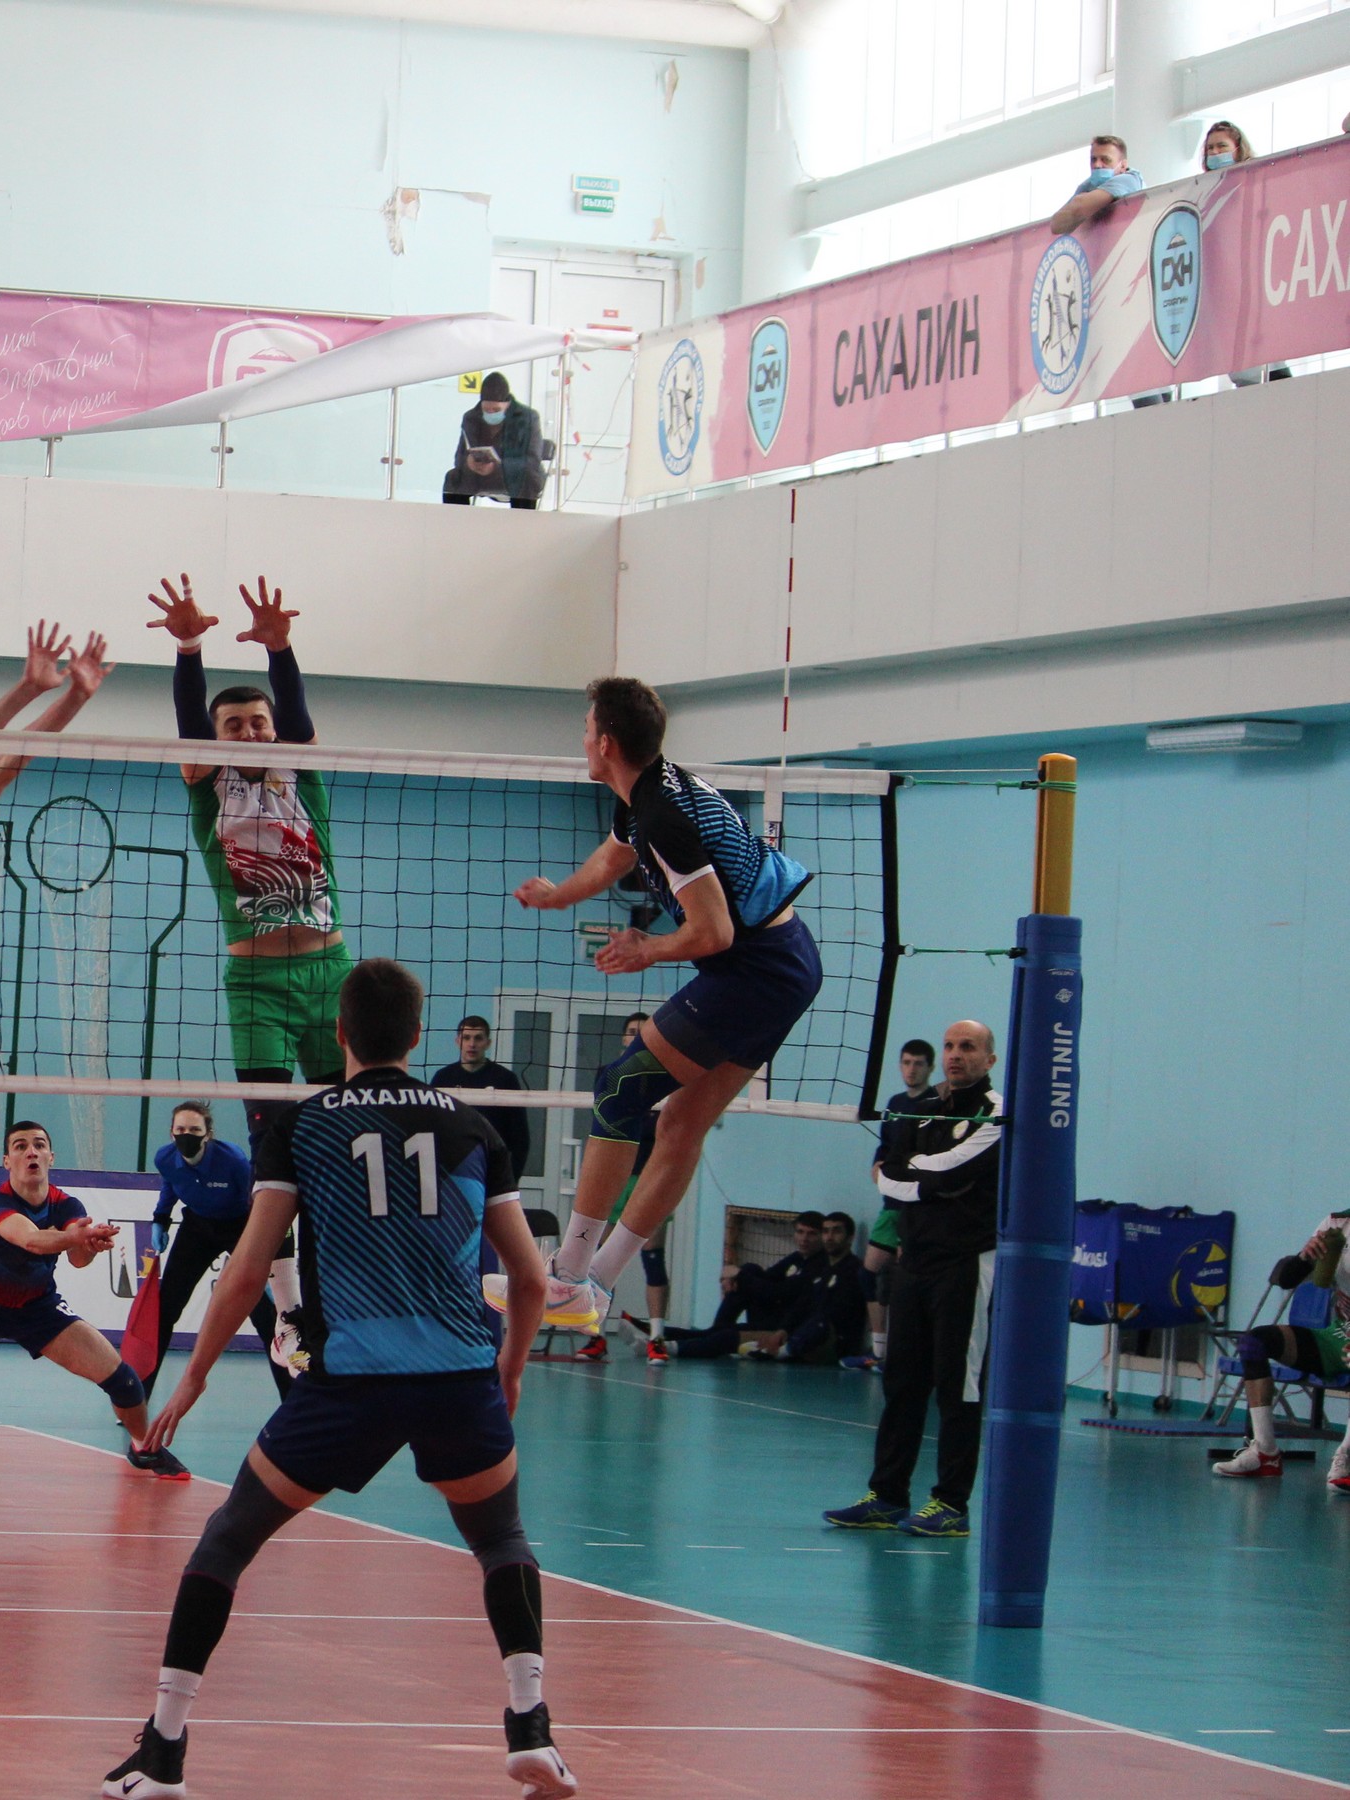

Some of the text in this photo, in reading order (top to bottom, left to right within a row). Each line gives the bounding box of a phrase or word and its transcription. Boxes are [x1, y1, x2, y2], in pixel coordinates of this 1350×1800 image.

[583, 197, 614, 210] ВЫХОД
[1264, 199, 1350, 306] САХ
[833, 295, 980, 408] САХАЛИН
[322, 1088, 456, 1112] САХАЛИН
[1049, 1022, 1074, 1128] JINLING
[351, 1132, 438, 1216] 11
